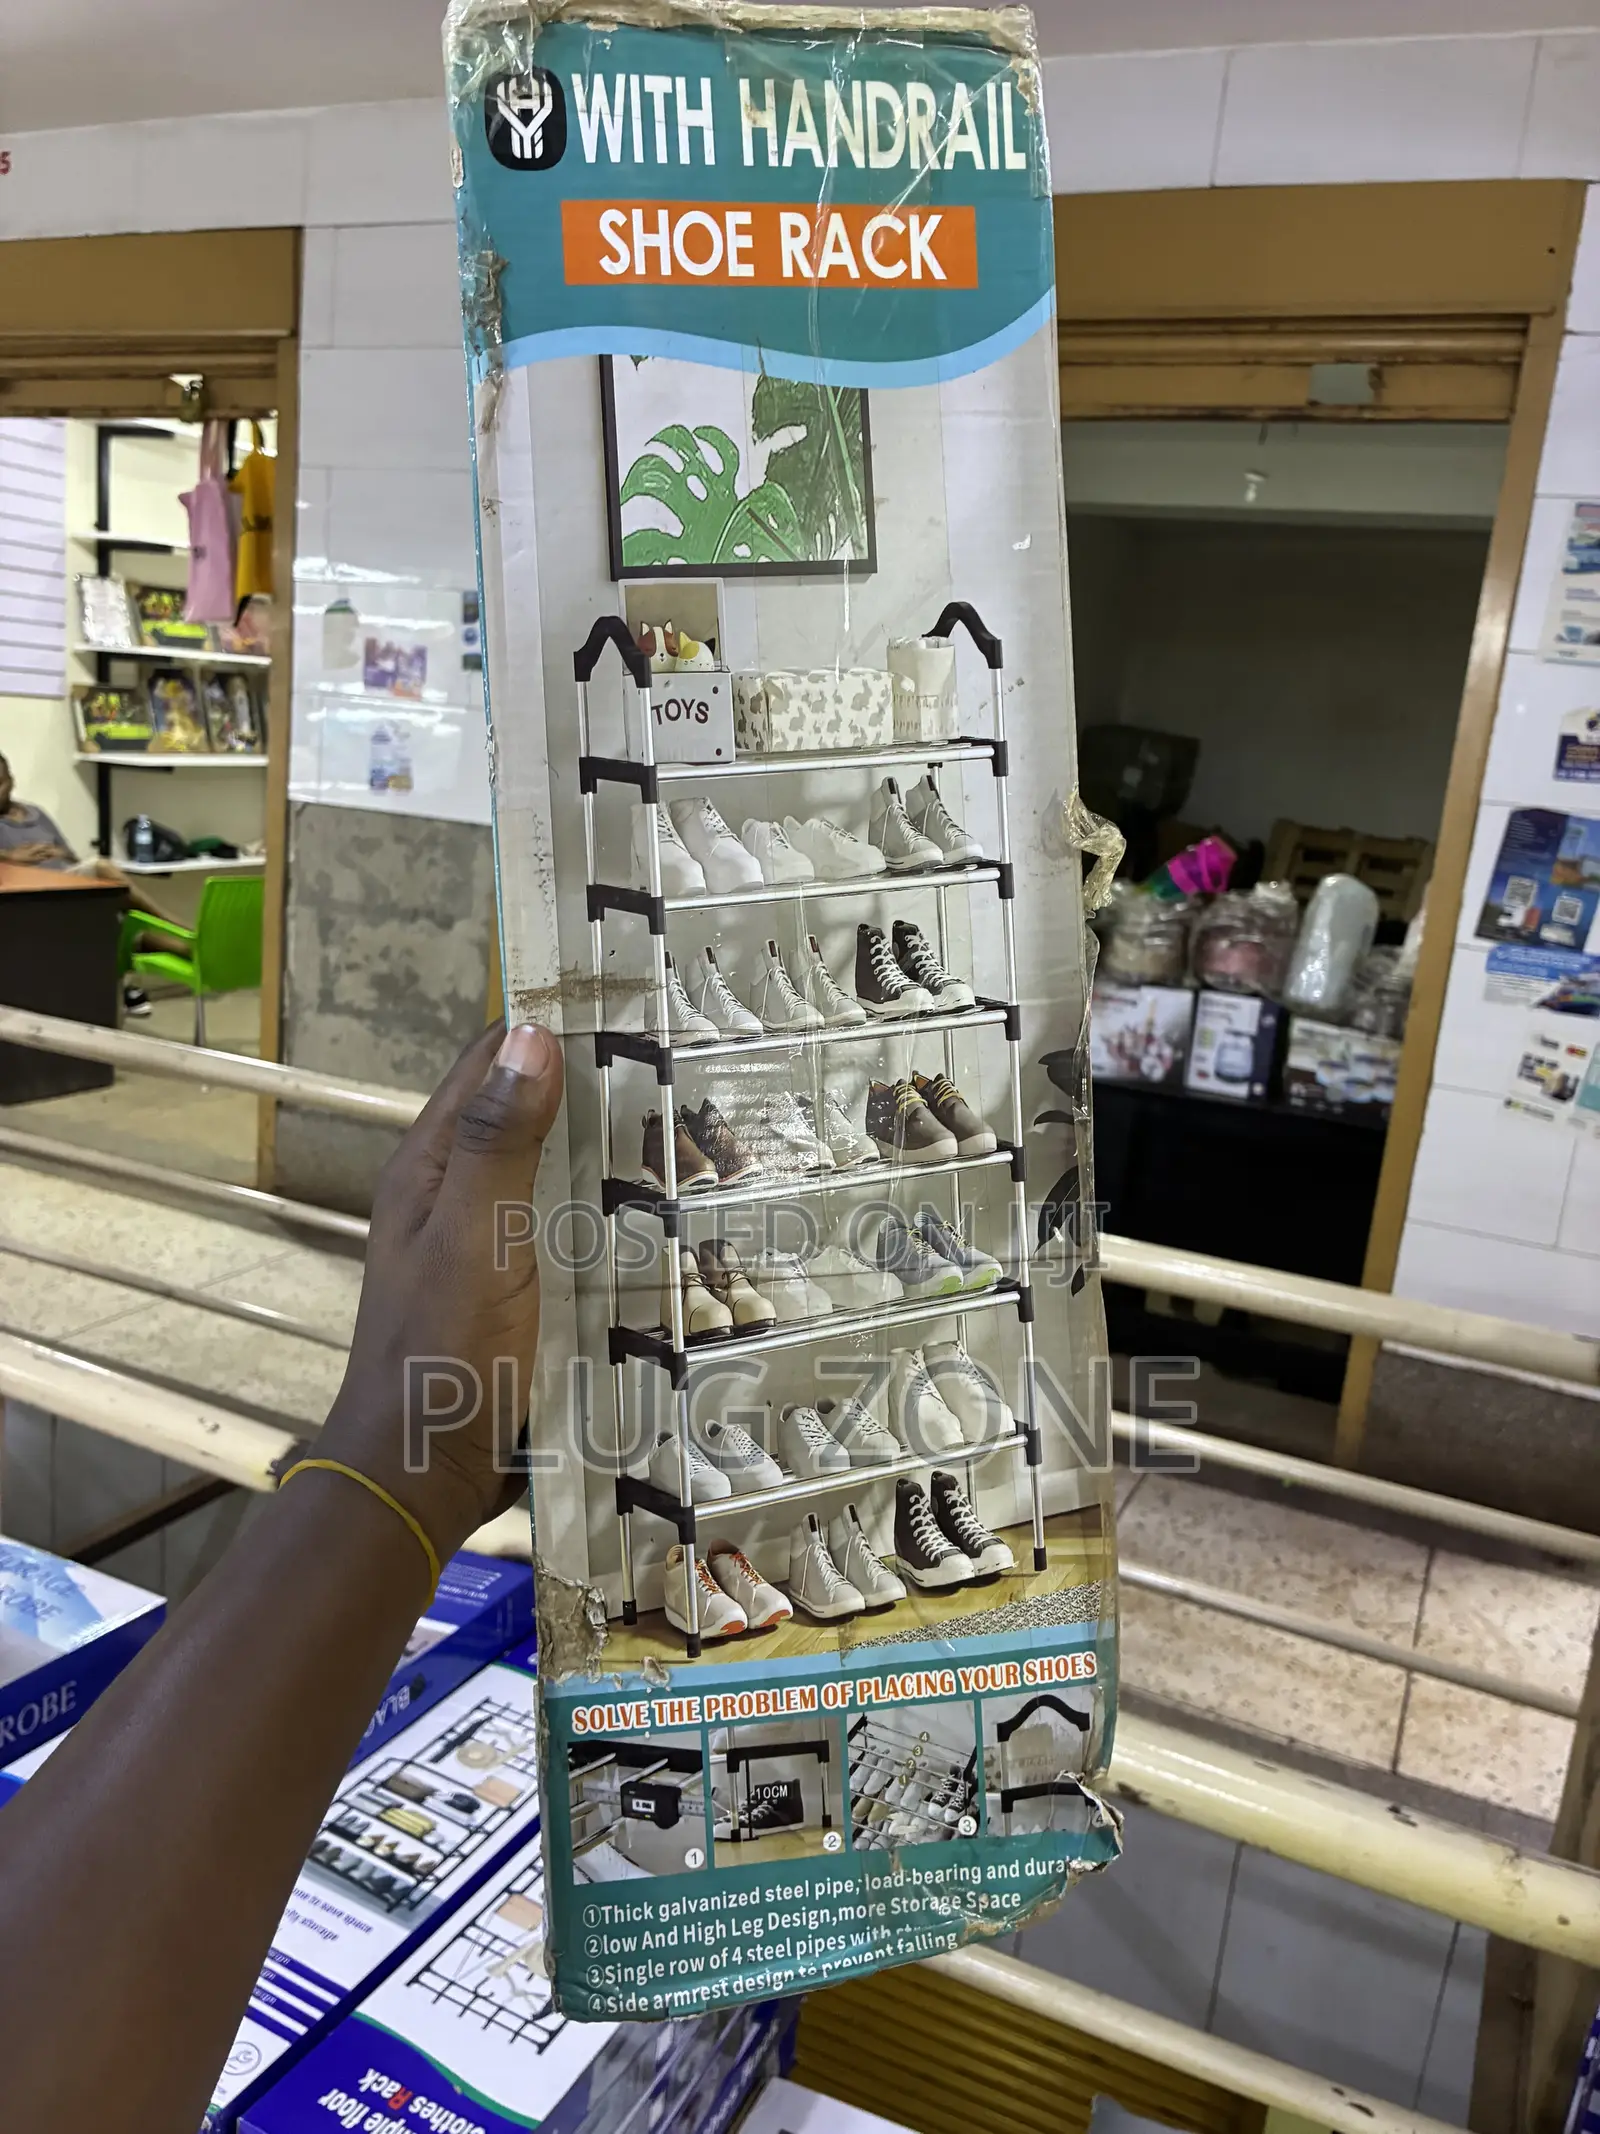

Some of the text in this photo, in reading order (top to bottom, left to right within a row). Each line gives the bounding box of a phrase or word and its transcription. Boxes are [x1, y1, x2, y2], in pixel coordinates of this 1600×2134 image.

[571, 72, 1027, 171] WITH HANDRAIL
[598, 207, 948, 282] SHOE RACK
[651, 697, 710, 726] TOYS
[572, 1651, 1097, 1735] SOLVE THE PROBLEM OF PLACING YOUR SHOES
[642, 1926, 679, 1950] And
[683, 1919, 727, 1946] High
[731, 1917, 763, 1938] Leg
[890, 1894, 961, 1915] Storage
[966, 1891, 1021, 1913] Space
[659, 1886, 761, 1922] galvanized
[765, 1878, 809, 1903] steel
[986, 1858, 1020, 1879] and
[653, 1977, 729, 2009] armrest
[732, 1968, 794, 1991] design
[897, 1932, 958, 1954] falling
[669, 1956, 705, 1976] row
[709, 1947, 729, 1970] of
[732, 1947, 743, 1965] 4
[747, 1937, 792, 1963] steel
[796, 1934, 846, 1961] pipes
[850, 1924, 891, 1947] with
[317, 2088, 370, 2129] floor
[358, 2067, 413, 2110] Rack
